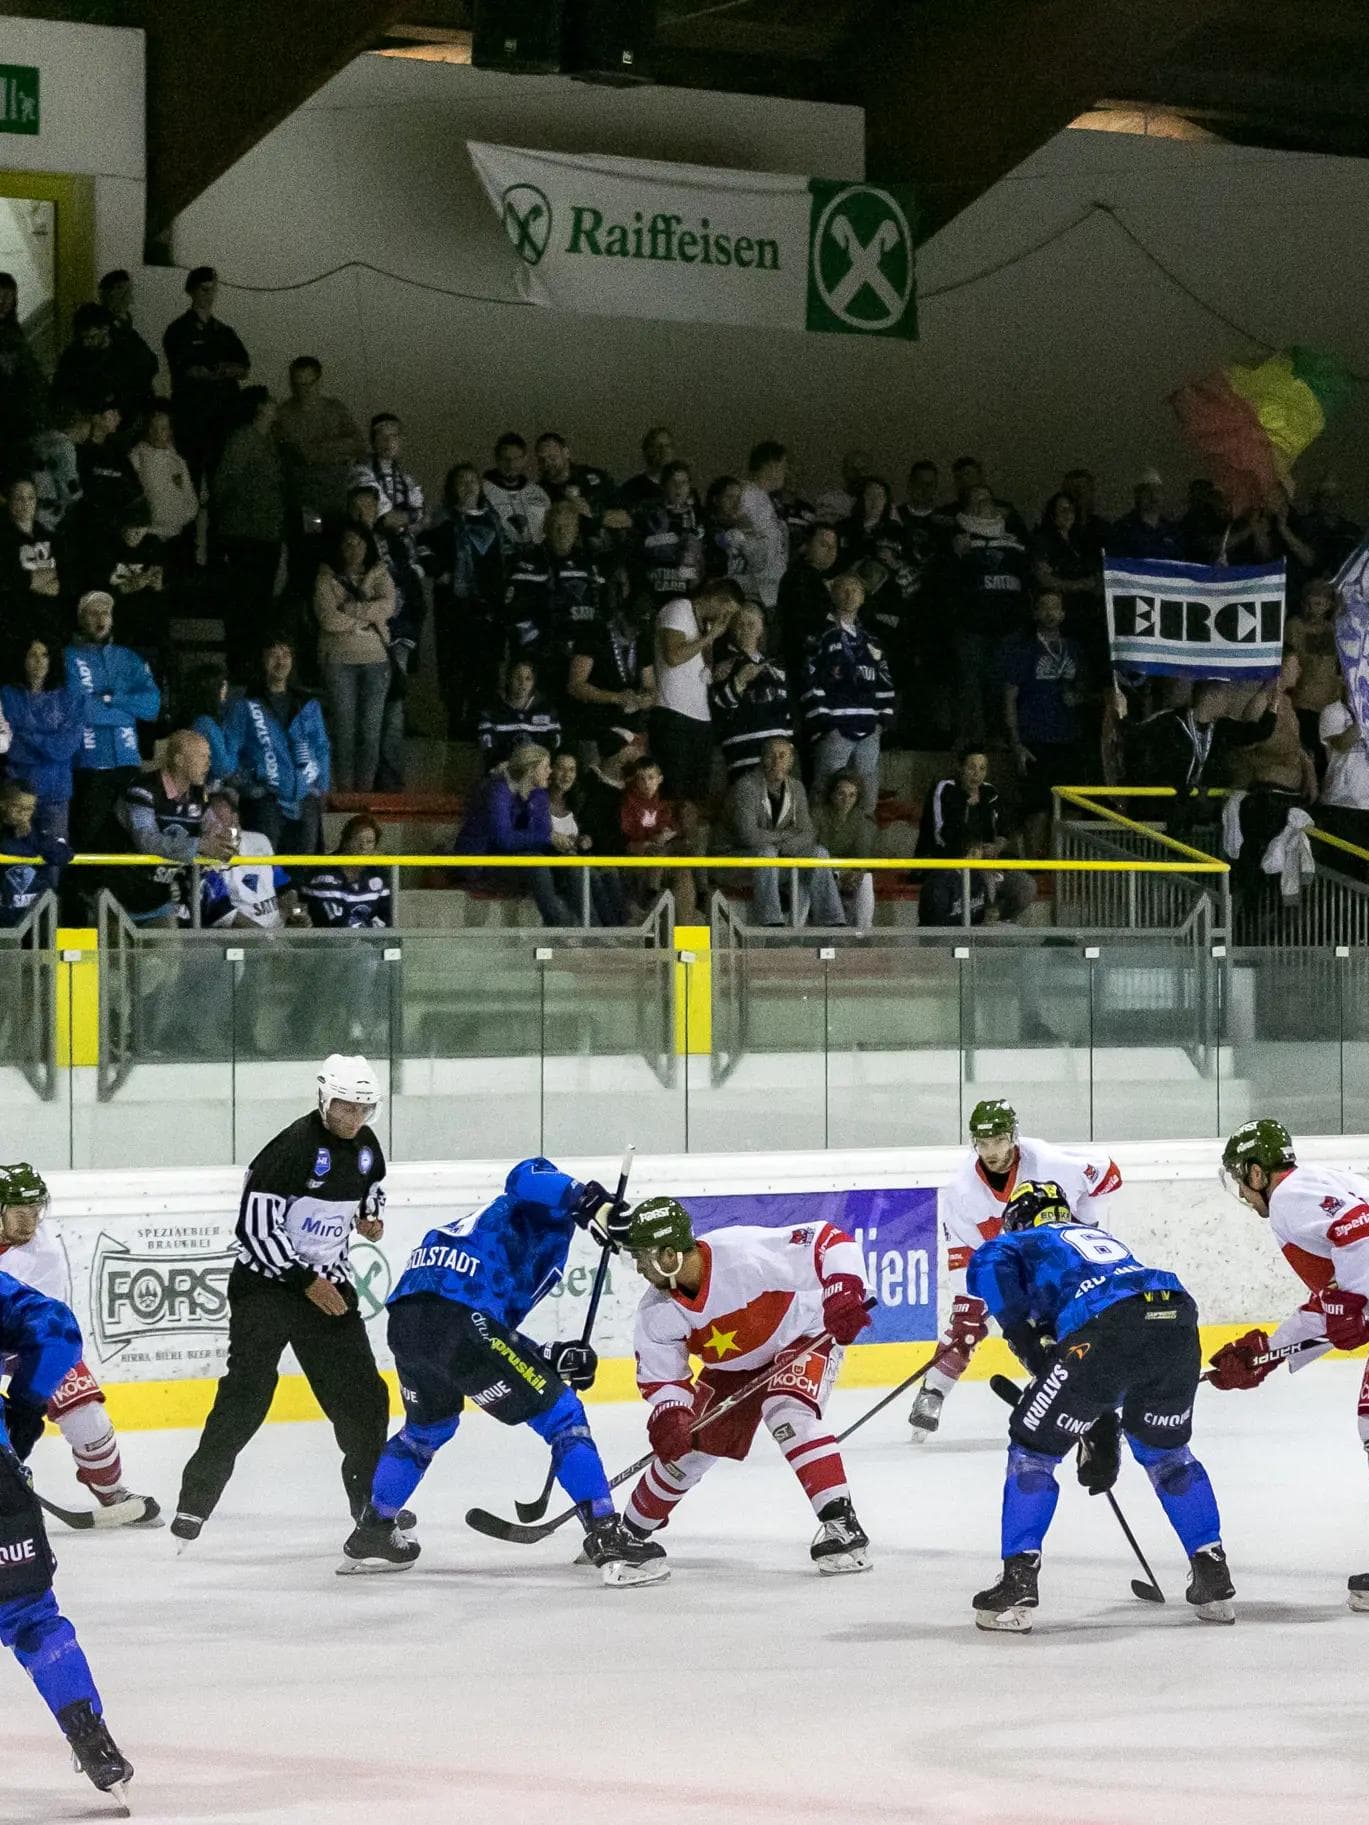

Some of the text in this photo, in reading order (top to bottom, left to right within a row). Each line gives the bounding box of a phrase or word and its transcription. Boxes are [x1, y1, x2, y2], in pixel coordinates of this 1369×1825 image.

[565, 206, 782, 270] Raiffeisen
[301, 1217, 344, 1238] Miro
[106, 1267, 232, 1326] FORS
[772, 1373, 818, 1396] KOCH
[1023, 1363, 1069, 1432] SATURN
[1055, 1412, 1094, 1435] CINQ
